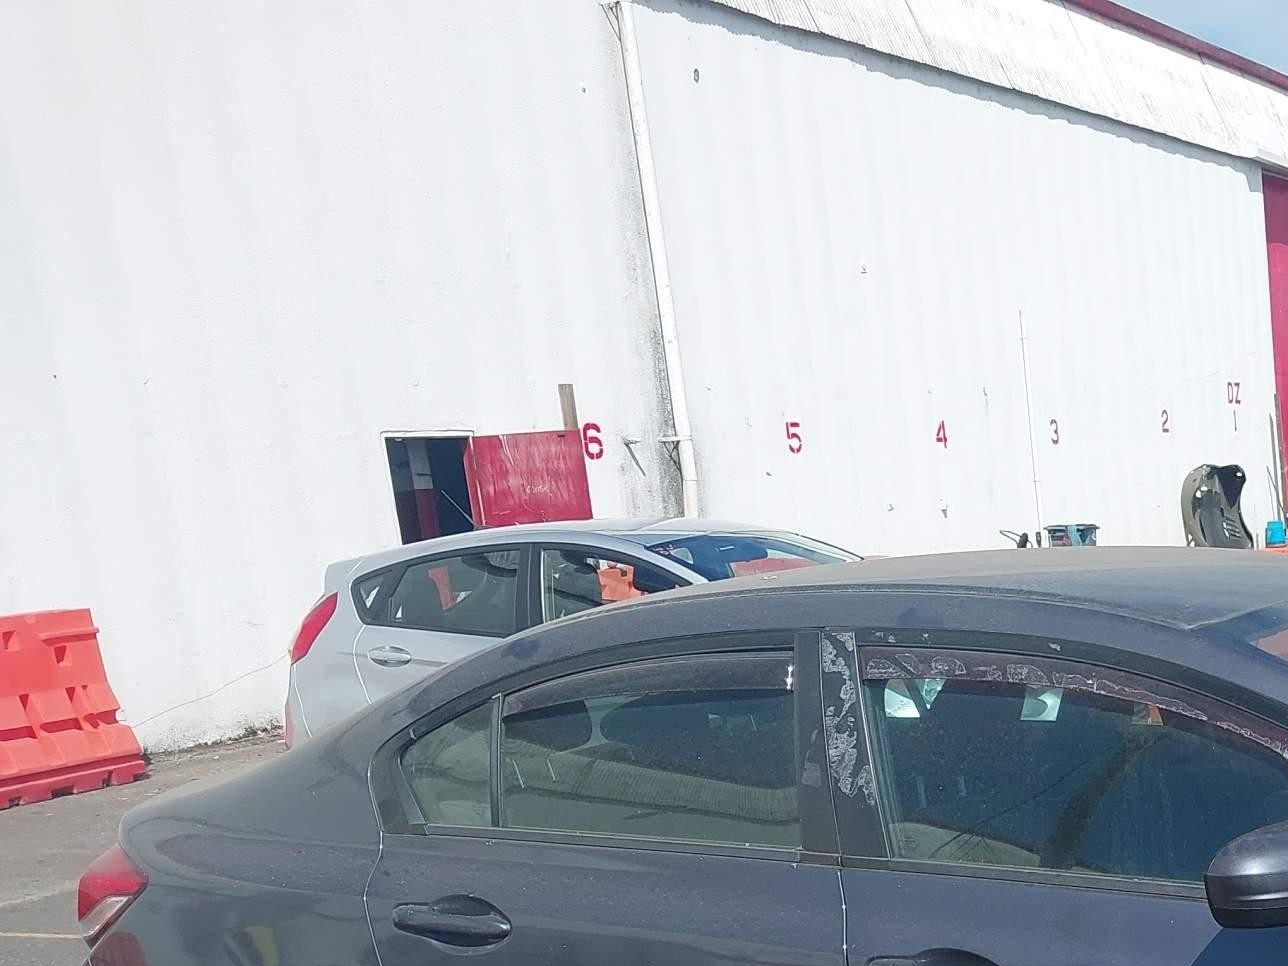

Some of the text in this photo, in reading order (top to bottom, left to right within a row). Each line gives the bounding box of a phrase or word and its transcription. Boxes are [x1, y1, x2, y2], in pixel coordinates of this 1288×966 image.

[935, 420, 948, 449] 4
[1050, 418, 1060, 445] 3
[1161, 409, 1170, 433] 2
[582, 422, 604, 460] 6
[785, 421, 802, 454] 5
